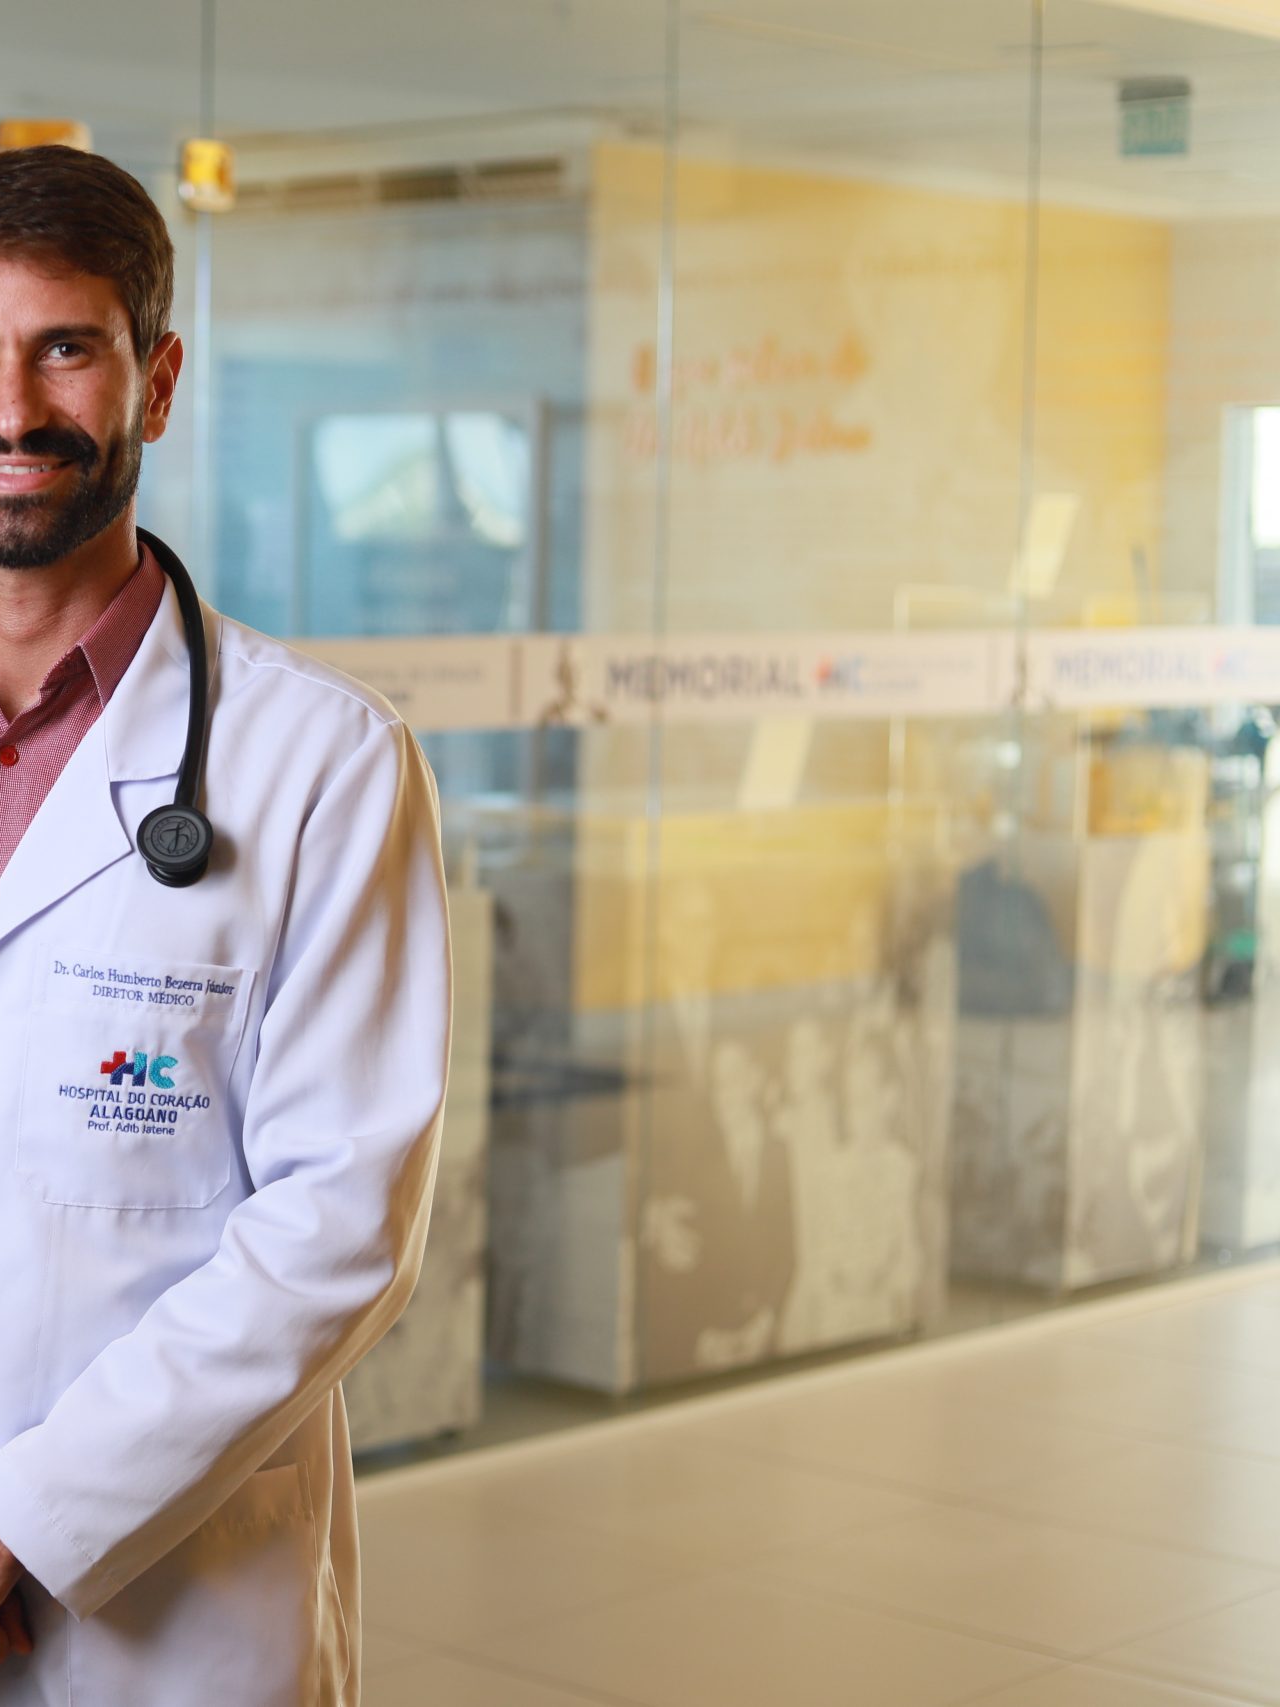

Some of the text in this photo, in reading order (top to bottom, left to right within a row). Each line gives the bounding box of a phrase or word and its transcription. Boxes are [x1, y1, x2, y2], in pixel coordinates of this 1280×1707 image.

[606, 653, 805, 700] MEMORIAL
[54, 960, 69, 975] Dr.
[72, 963, 105, 981] Carlos
[107, 968, 162, 988] Humberto
[165, 975, 203, 991] Bezerra
[92, 984, 195, 1007] DIRETOR MÉDICO
[109, 1050, 178, 1089] HC
[59, 1084, 210, 1112] HOSPITAL DO CORAÇÃO
[87, 1120, 175, 1136] Prof. Adib Jatene
[89, 1104, 178, 1124] ALAGOANO
